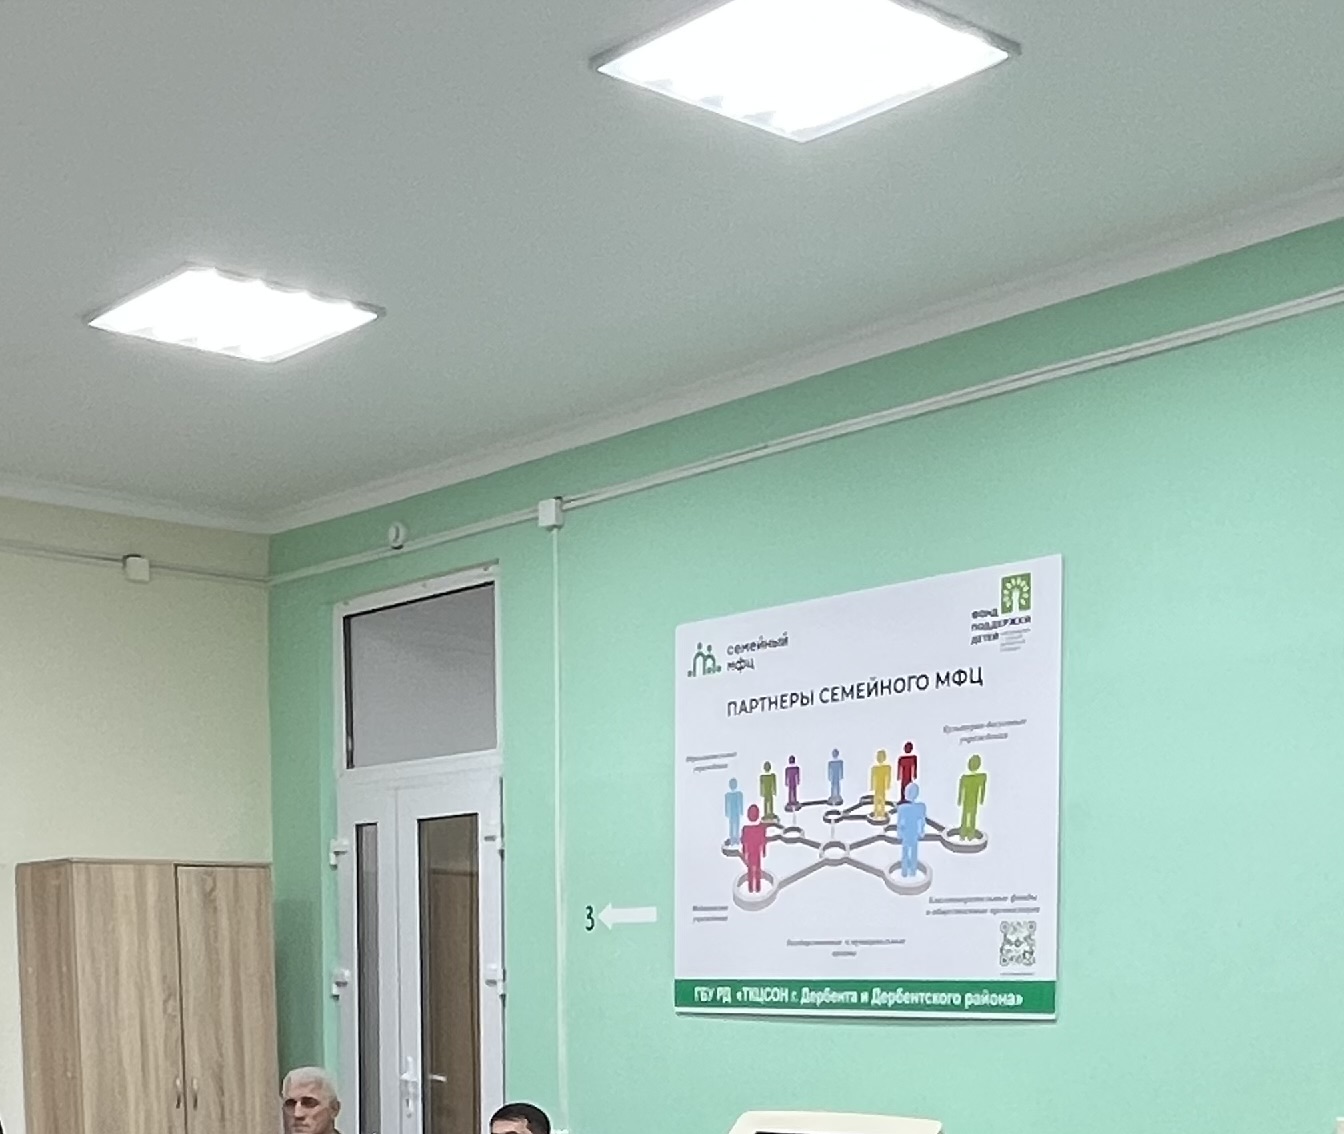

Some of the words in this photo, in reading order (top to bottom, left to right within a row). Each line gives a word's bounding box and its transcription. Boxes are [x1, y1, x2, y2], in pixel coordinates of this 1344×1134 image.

[727, 689, 814, 717] ПАРТНЕРЫ
[819, 674, 929, 704] СЕМЕЙНОГО
[934, 666, 984, 689] МФЦ
[585, 905, 595, 931] 3
[694, 987, 714, 1002] ГБУ
[716, 987, 732, 1004] РД
[800, 987, 857, 1007] Дербента
[860, 991, 869, 1003] и
[871, 987, 961, 1007] Дербентского
[964, 989, 1024, 1009] района»
